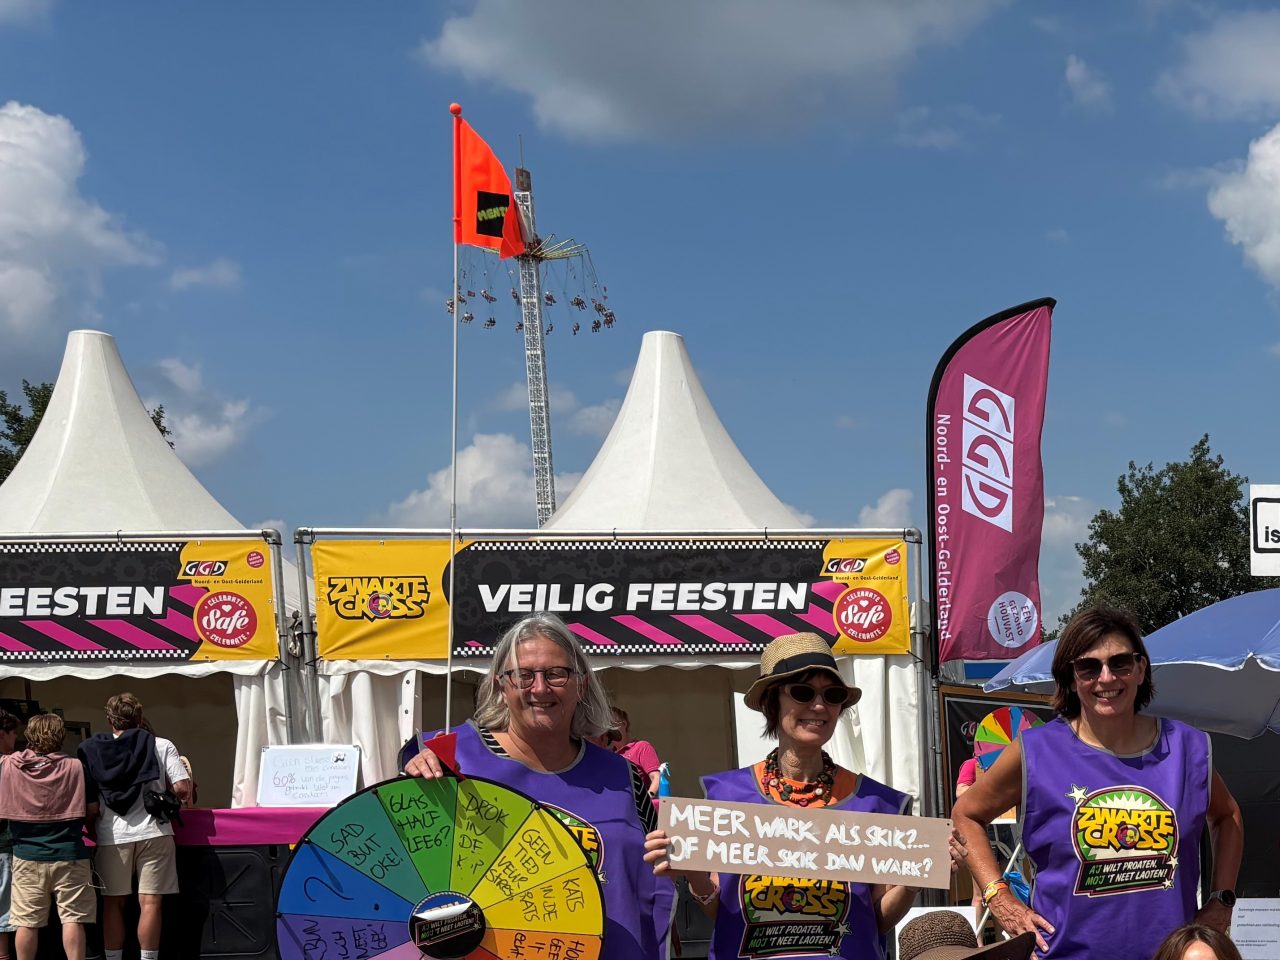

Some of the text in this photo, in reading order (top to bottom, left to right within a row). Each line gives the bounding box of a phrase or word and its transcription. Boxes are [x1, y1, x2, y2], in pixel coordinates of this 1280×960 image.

[965, 388, 1011, 518] GGD
[937, 414, 951, 640] Noord- en Oost-Gelderland
[1265, 526, 1280, 543] is
[185, 561, 225, 575] GGD
[827, 559, 865, 572] GGD
[207, 594, 245, 607] CELEBRATE
[330, 576, 430, 602] ZWARTE
[478, 582, 807, 613] VEILIG FEESTEN
[846, 591, 880, 602] CELEBRATE
[337, 594, 425, 619] CROSS
[841, 604, 885, 629] Safe
[1009, 600, 1024, 636] GEZOND
[1021, 606, 1032, 624] EEN
[202, 609, 249, 634] Safe
[847, 628, 882, 640] CELEBRATE
[998, 602, 1015, 642] HOUVAST
[210, 634, 247, 646] CELEBRATE
[961, 722, 979, 735] GG
[397, 810, 440, 831] HALF
[669, 803, 750, 837] MEER
[753, 815, 821, 844] WARK
[824, 822, 861, 846] ALS
[1078, 807, 1174, 829] ZWARTE
[330, 823, 365, 854] SAD
[348, 833, 382, 866] BUT
[521, 828, 555, 865] GEEN
[369, 847, 404, 880] OKE!
[514, 842, 539, 874] TIED
[668, 835, 933, 878] OF MEER SKIK DAN WARK?
[498, 856, 528, 889] VEUR
[520, 891, 540, 922] RATS
[562, 878, 584, 913] KATS
[765, 926, 784, 935] WILT
[776, 937, 797, 946] NEET
